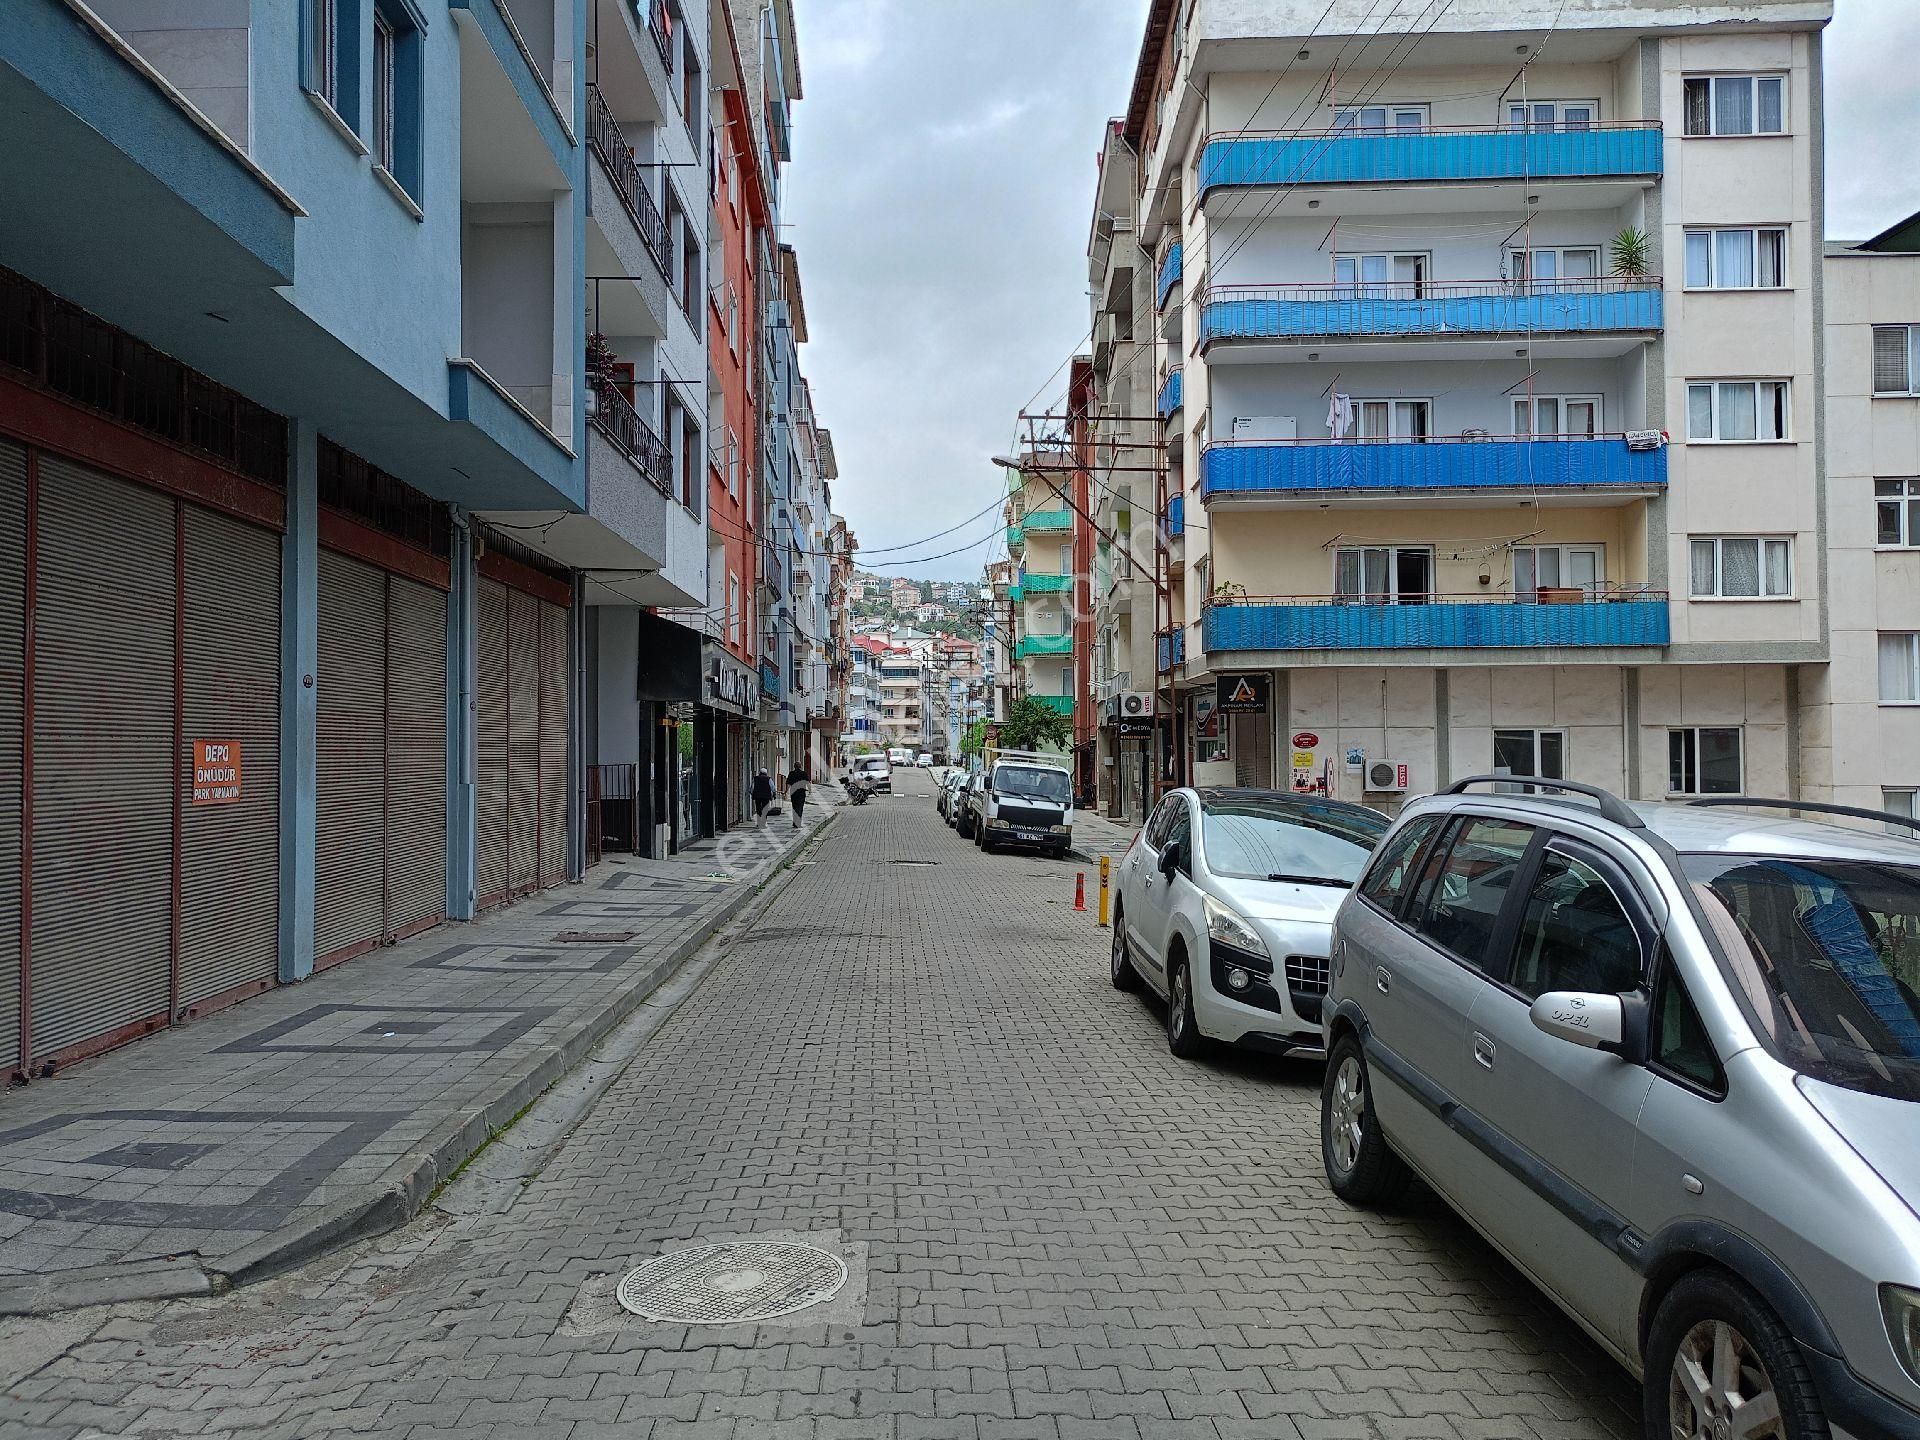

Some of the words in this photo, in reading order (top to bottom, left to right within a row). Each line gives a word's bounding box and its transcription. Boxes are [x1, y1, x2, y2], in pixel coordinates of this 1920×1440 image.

[205, 744, 230, 763] DEPO
[197, 766, 236, 783] ÖNÜDÜR
[194, 788, 211, 801] PARK
[211, 785, 240, 799] YAPMAYIN
[1551, 1010, 1590, 1029] OPEL
